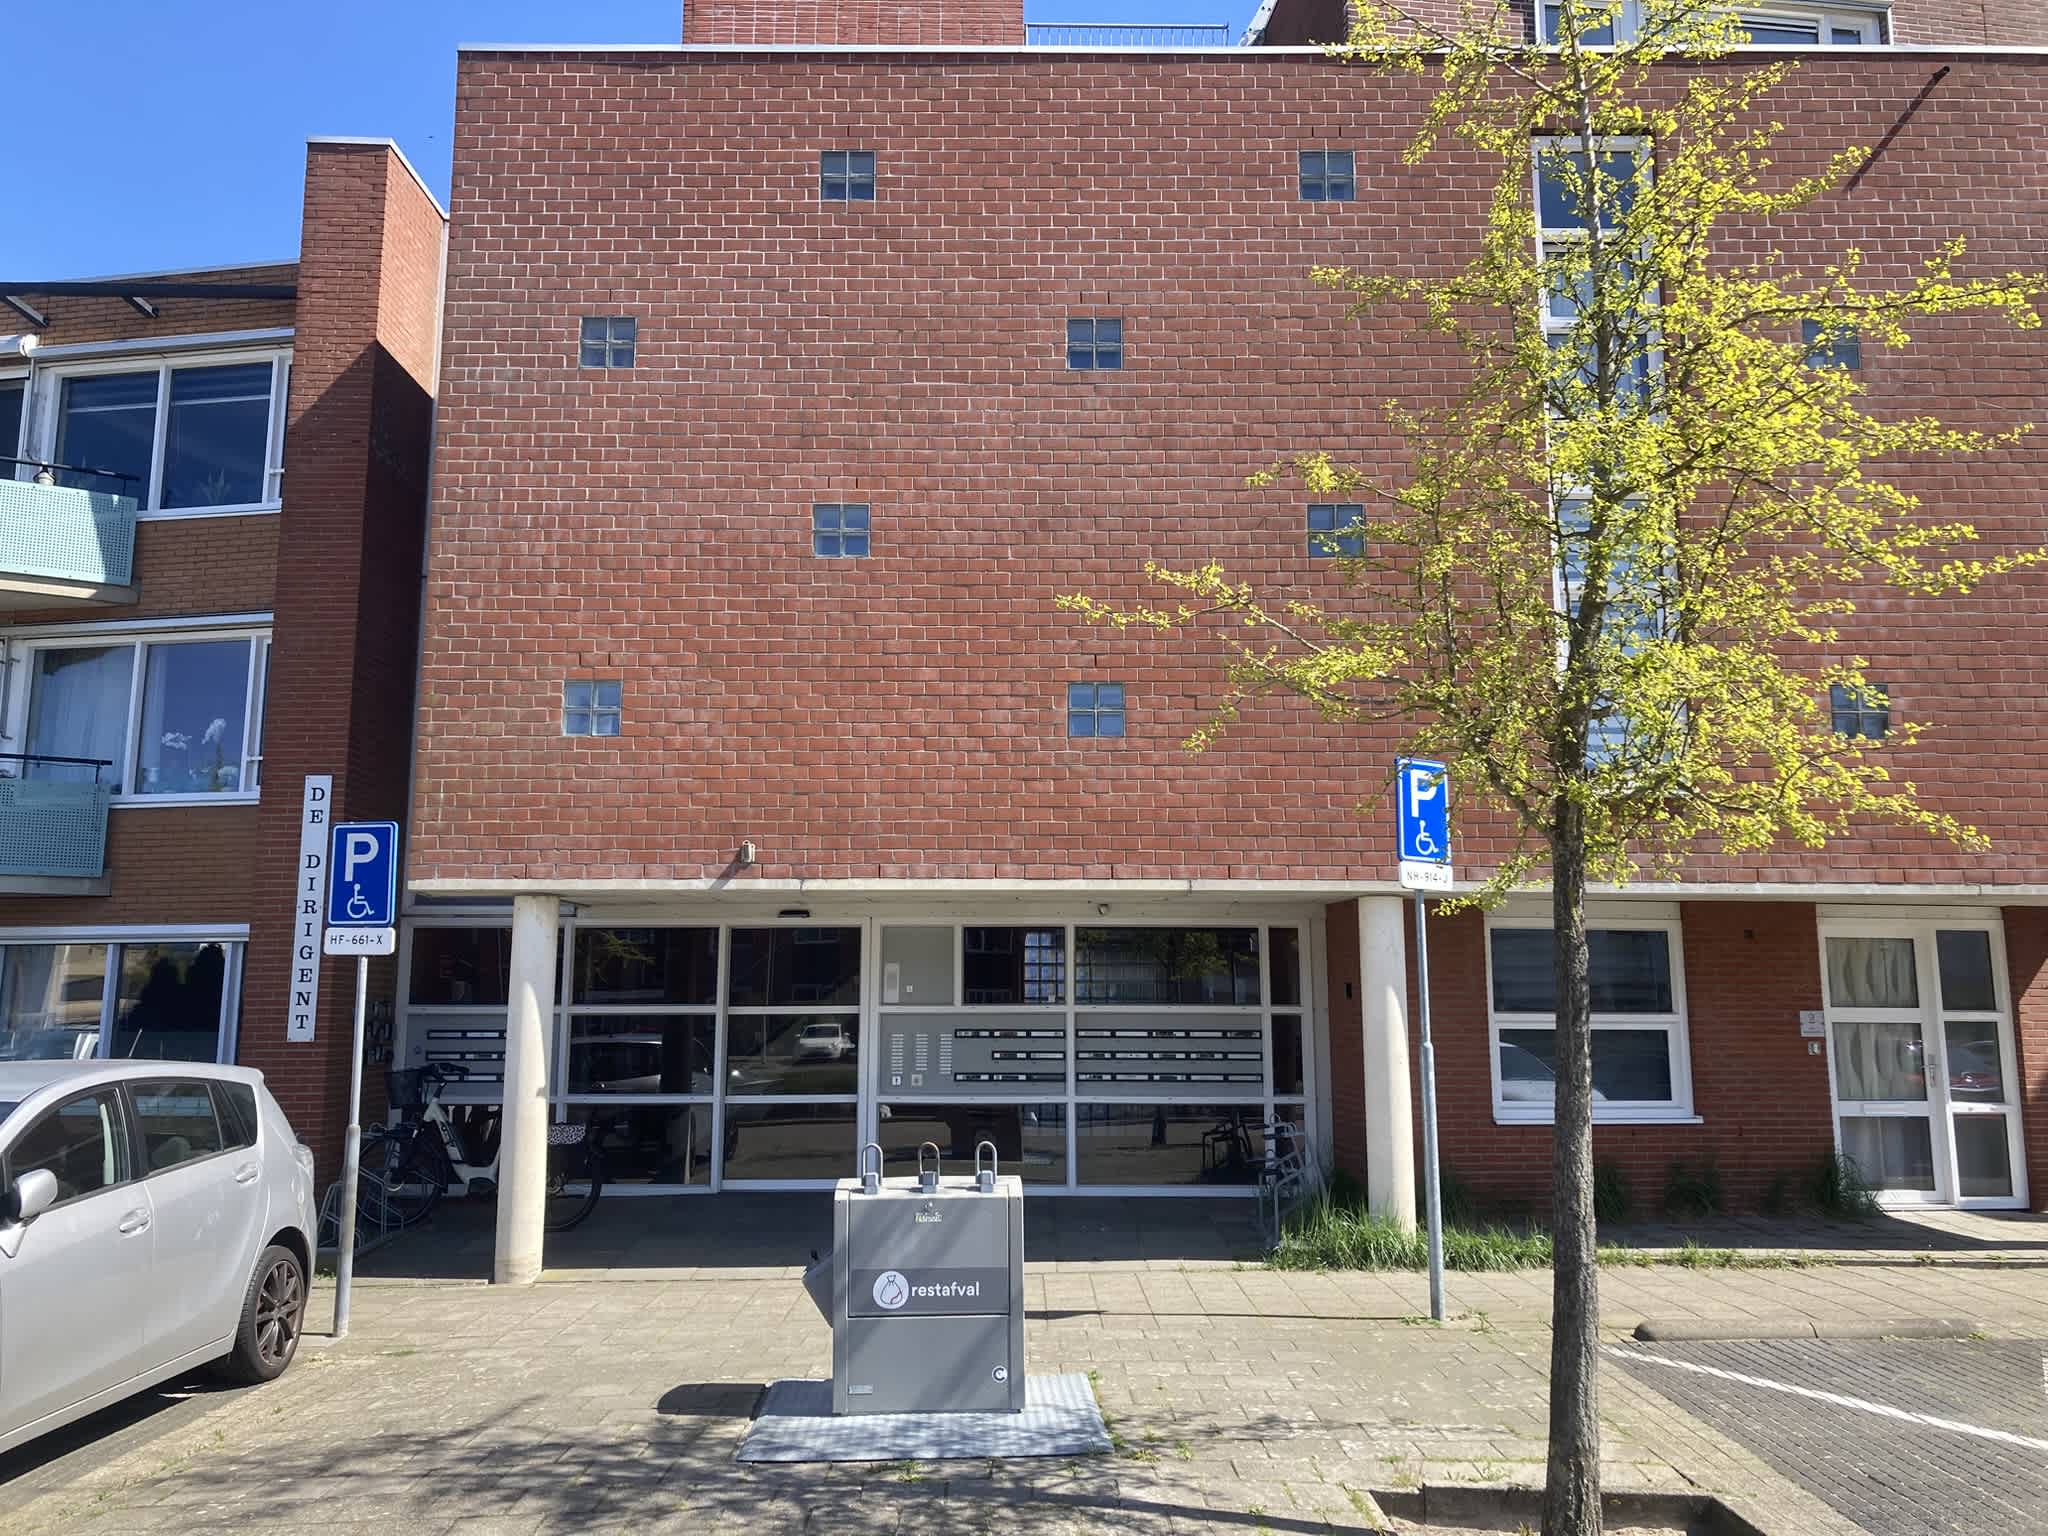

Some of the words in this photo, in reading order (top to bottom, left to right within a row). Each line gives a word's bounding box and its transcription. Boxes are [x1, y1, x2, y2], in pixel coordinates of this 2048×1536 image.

[309, 787, 326, 824] DE
[1410, 769, 1437, 818] P
[343, 832, 380, 882] P
[295, 854, 321, 1030] DIRIGENT
[330, 934, 384, 946] HF-661-X
[911, 1281, 980, 1297] restafval
